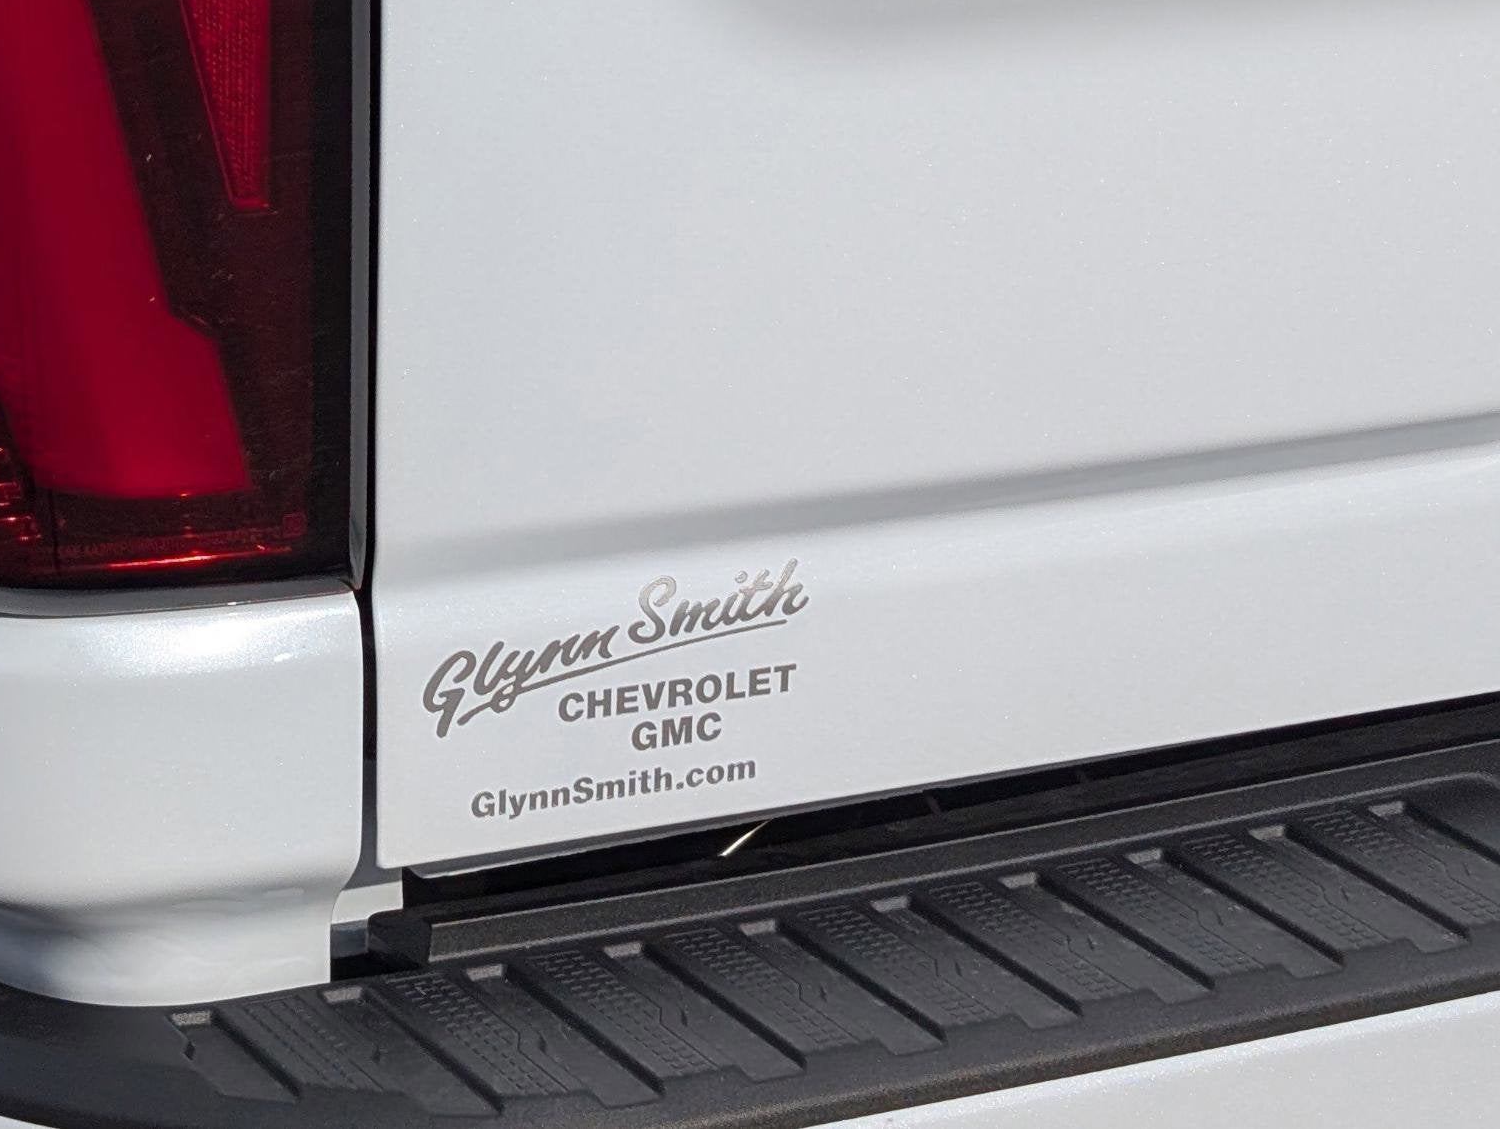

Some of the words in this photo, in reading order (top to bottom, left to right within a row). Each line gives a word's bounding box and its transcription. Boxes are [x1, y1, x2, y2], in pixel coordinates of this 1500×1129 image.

[422, 624, 620, 739] Glynn
[627, 557, 810, 644] Smith
[557, 663, 798, 723] CHEVROLET
[630, 711, 723, 752] GMC
[470, 759, 757, 820] GlynnSmith.com
